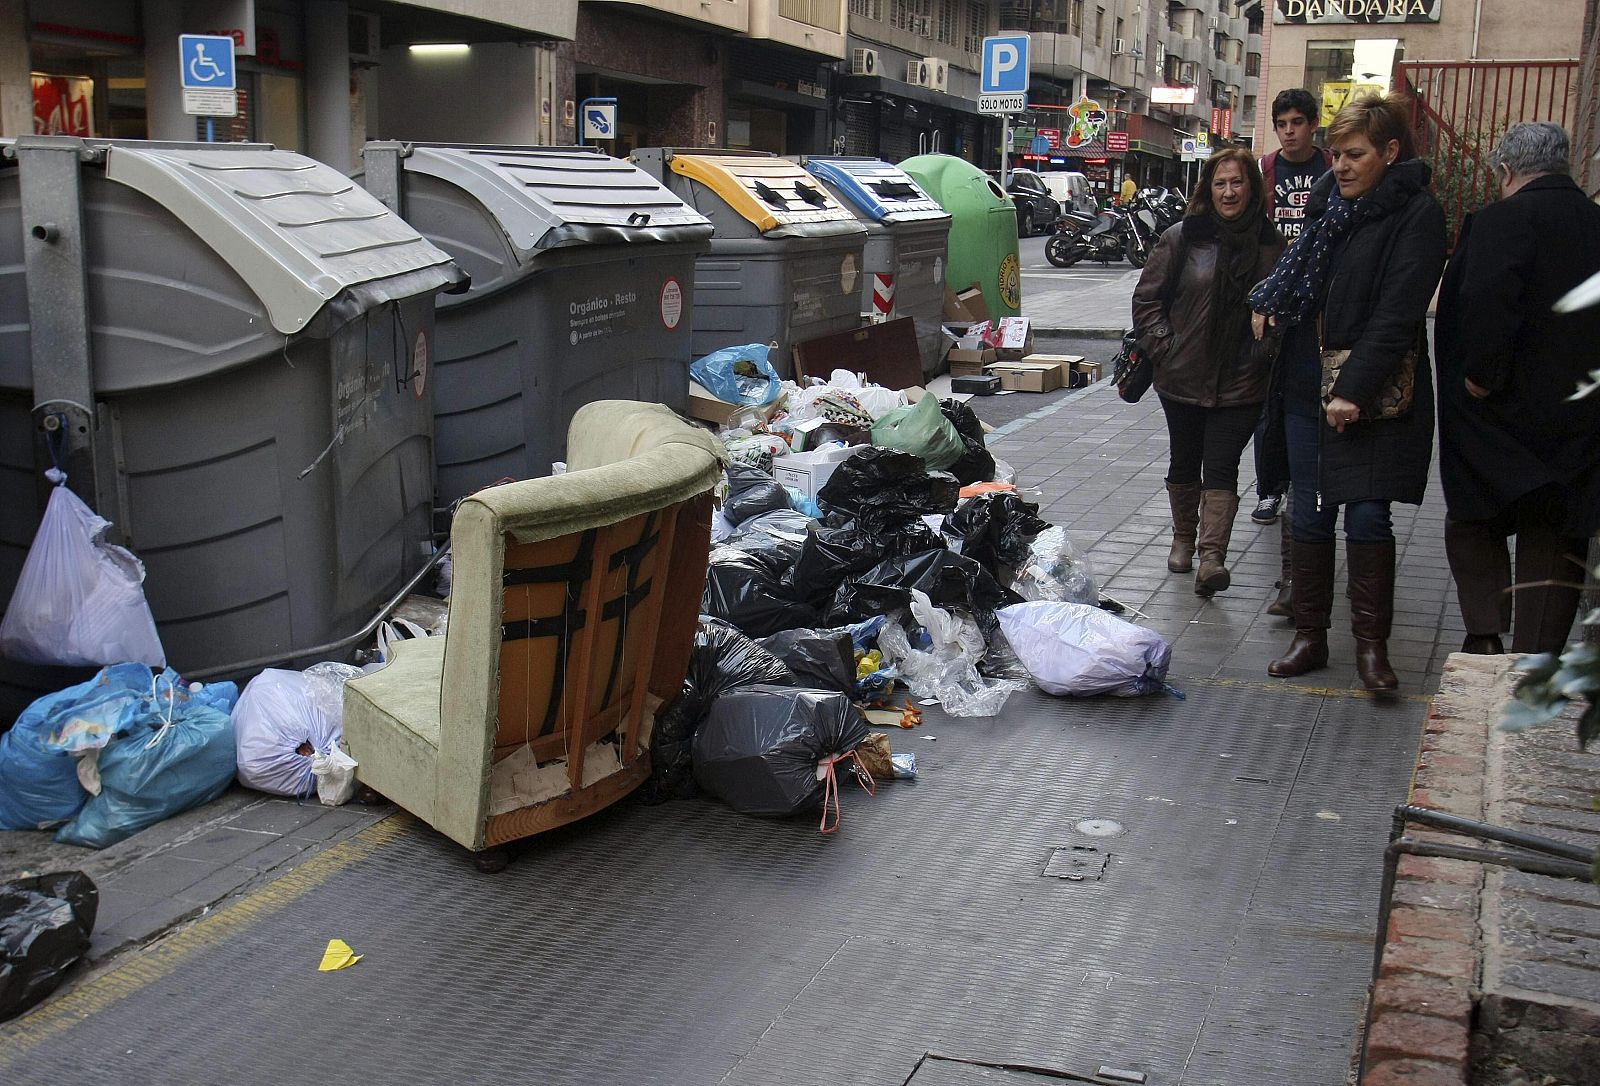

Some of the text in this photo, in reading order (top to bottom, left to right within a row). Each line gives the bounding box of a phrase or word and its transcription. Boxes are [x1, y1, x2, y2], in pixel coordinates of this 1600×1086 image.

[1286, 0, 1428, 17] DANDARA
[991, 43, 1018, 86] P
[981, 98, 1022, 109] SÓLO MOTOS
[1275, 175, 1313, 197] RANK
[1276, 223, 1304, 237] ARS
[570, 292, 637, 315] Orgánico Resto
